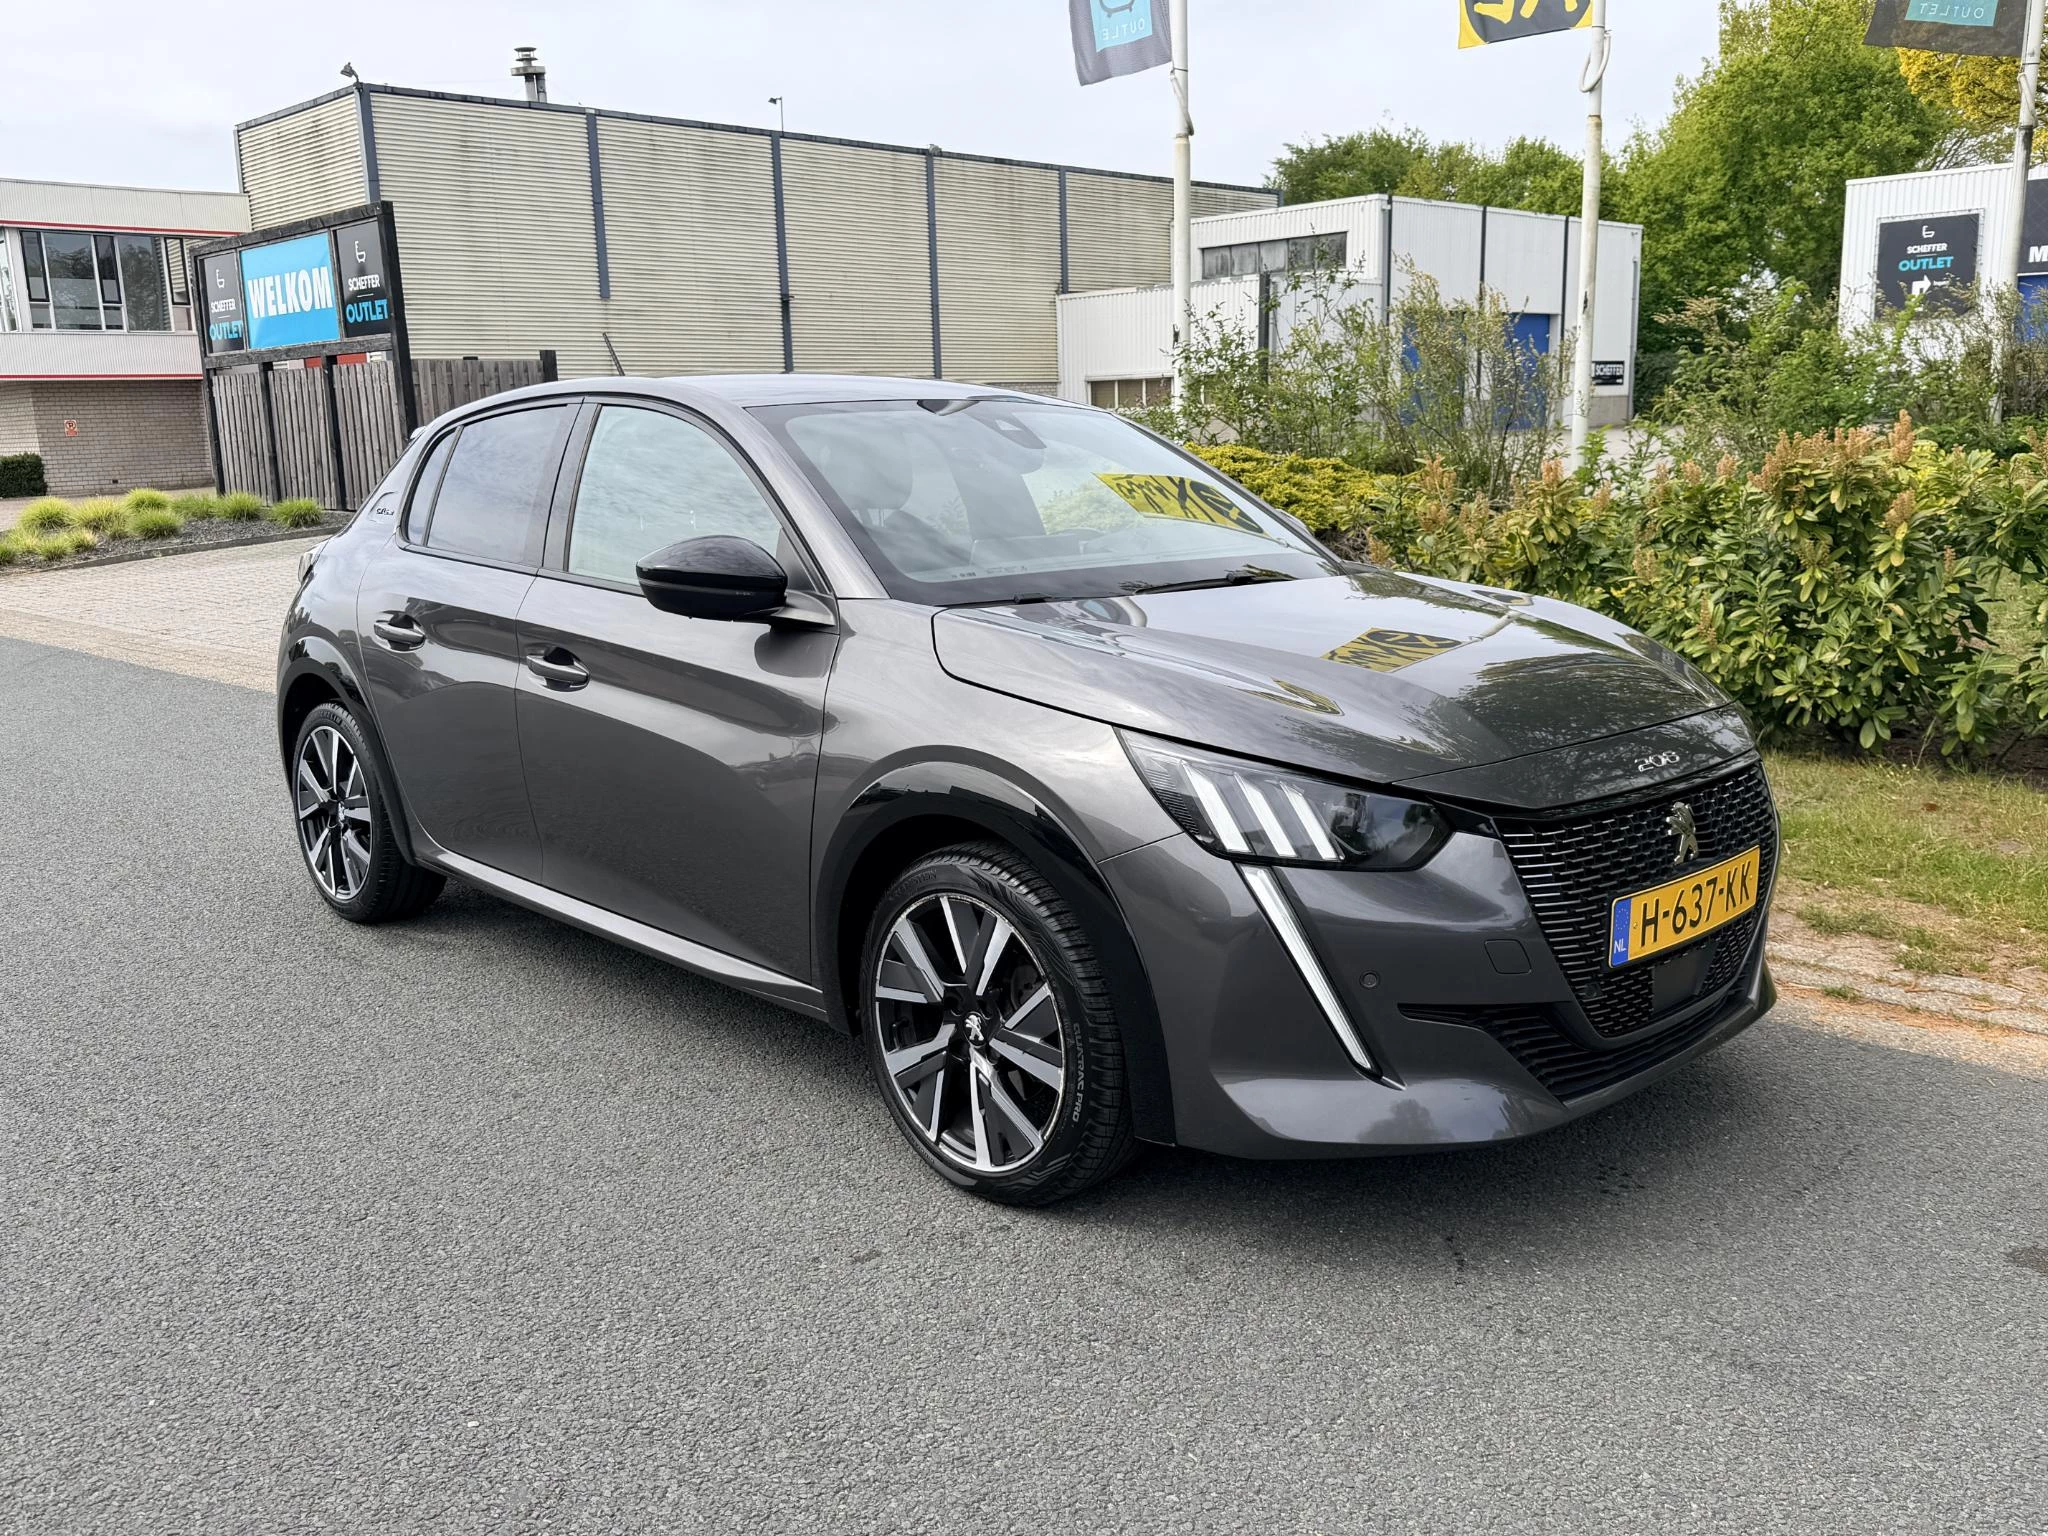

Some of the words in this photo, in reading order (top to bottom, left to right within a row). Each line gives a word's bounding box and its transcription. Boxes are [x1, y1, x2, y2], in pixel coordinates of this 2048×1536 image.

[1906, 243, 1948, 254] SCHEFFER
[1898, 257, 1954, 271] OUTLET
[348, 275, 380, 290] SCHEFFER
[248, 267, 333, 318] WELKOM
[210, 299, 237, 313] SCHEFFER
[346, 300, 388, 323] OUTLET
[209, 321, 242, 340] OUTLET
[1596, 364, 1624, 376] SCHEFFER
[1634, 751, 1680, 772] 208
[1641, 861, 1751, 947] H-637-KK
[1613, 939, 1627, 953] NL
[1073, 1023, 1085, 1091] QUATRAC
[1072, 1093, 1083, 1123] PRO
